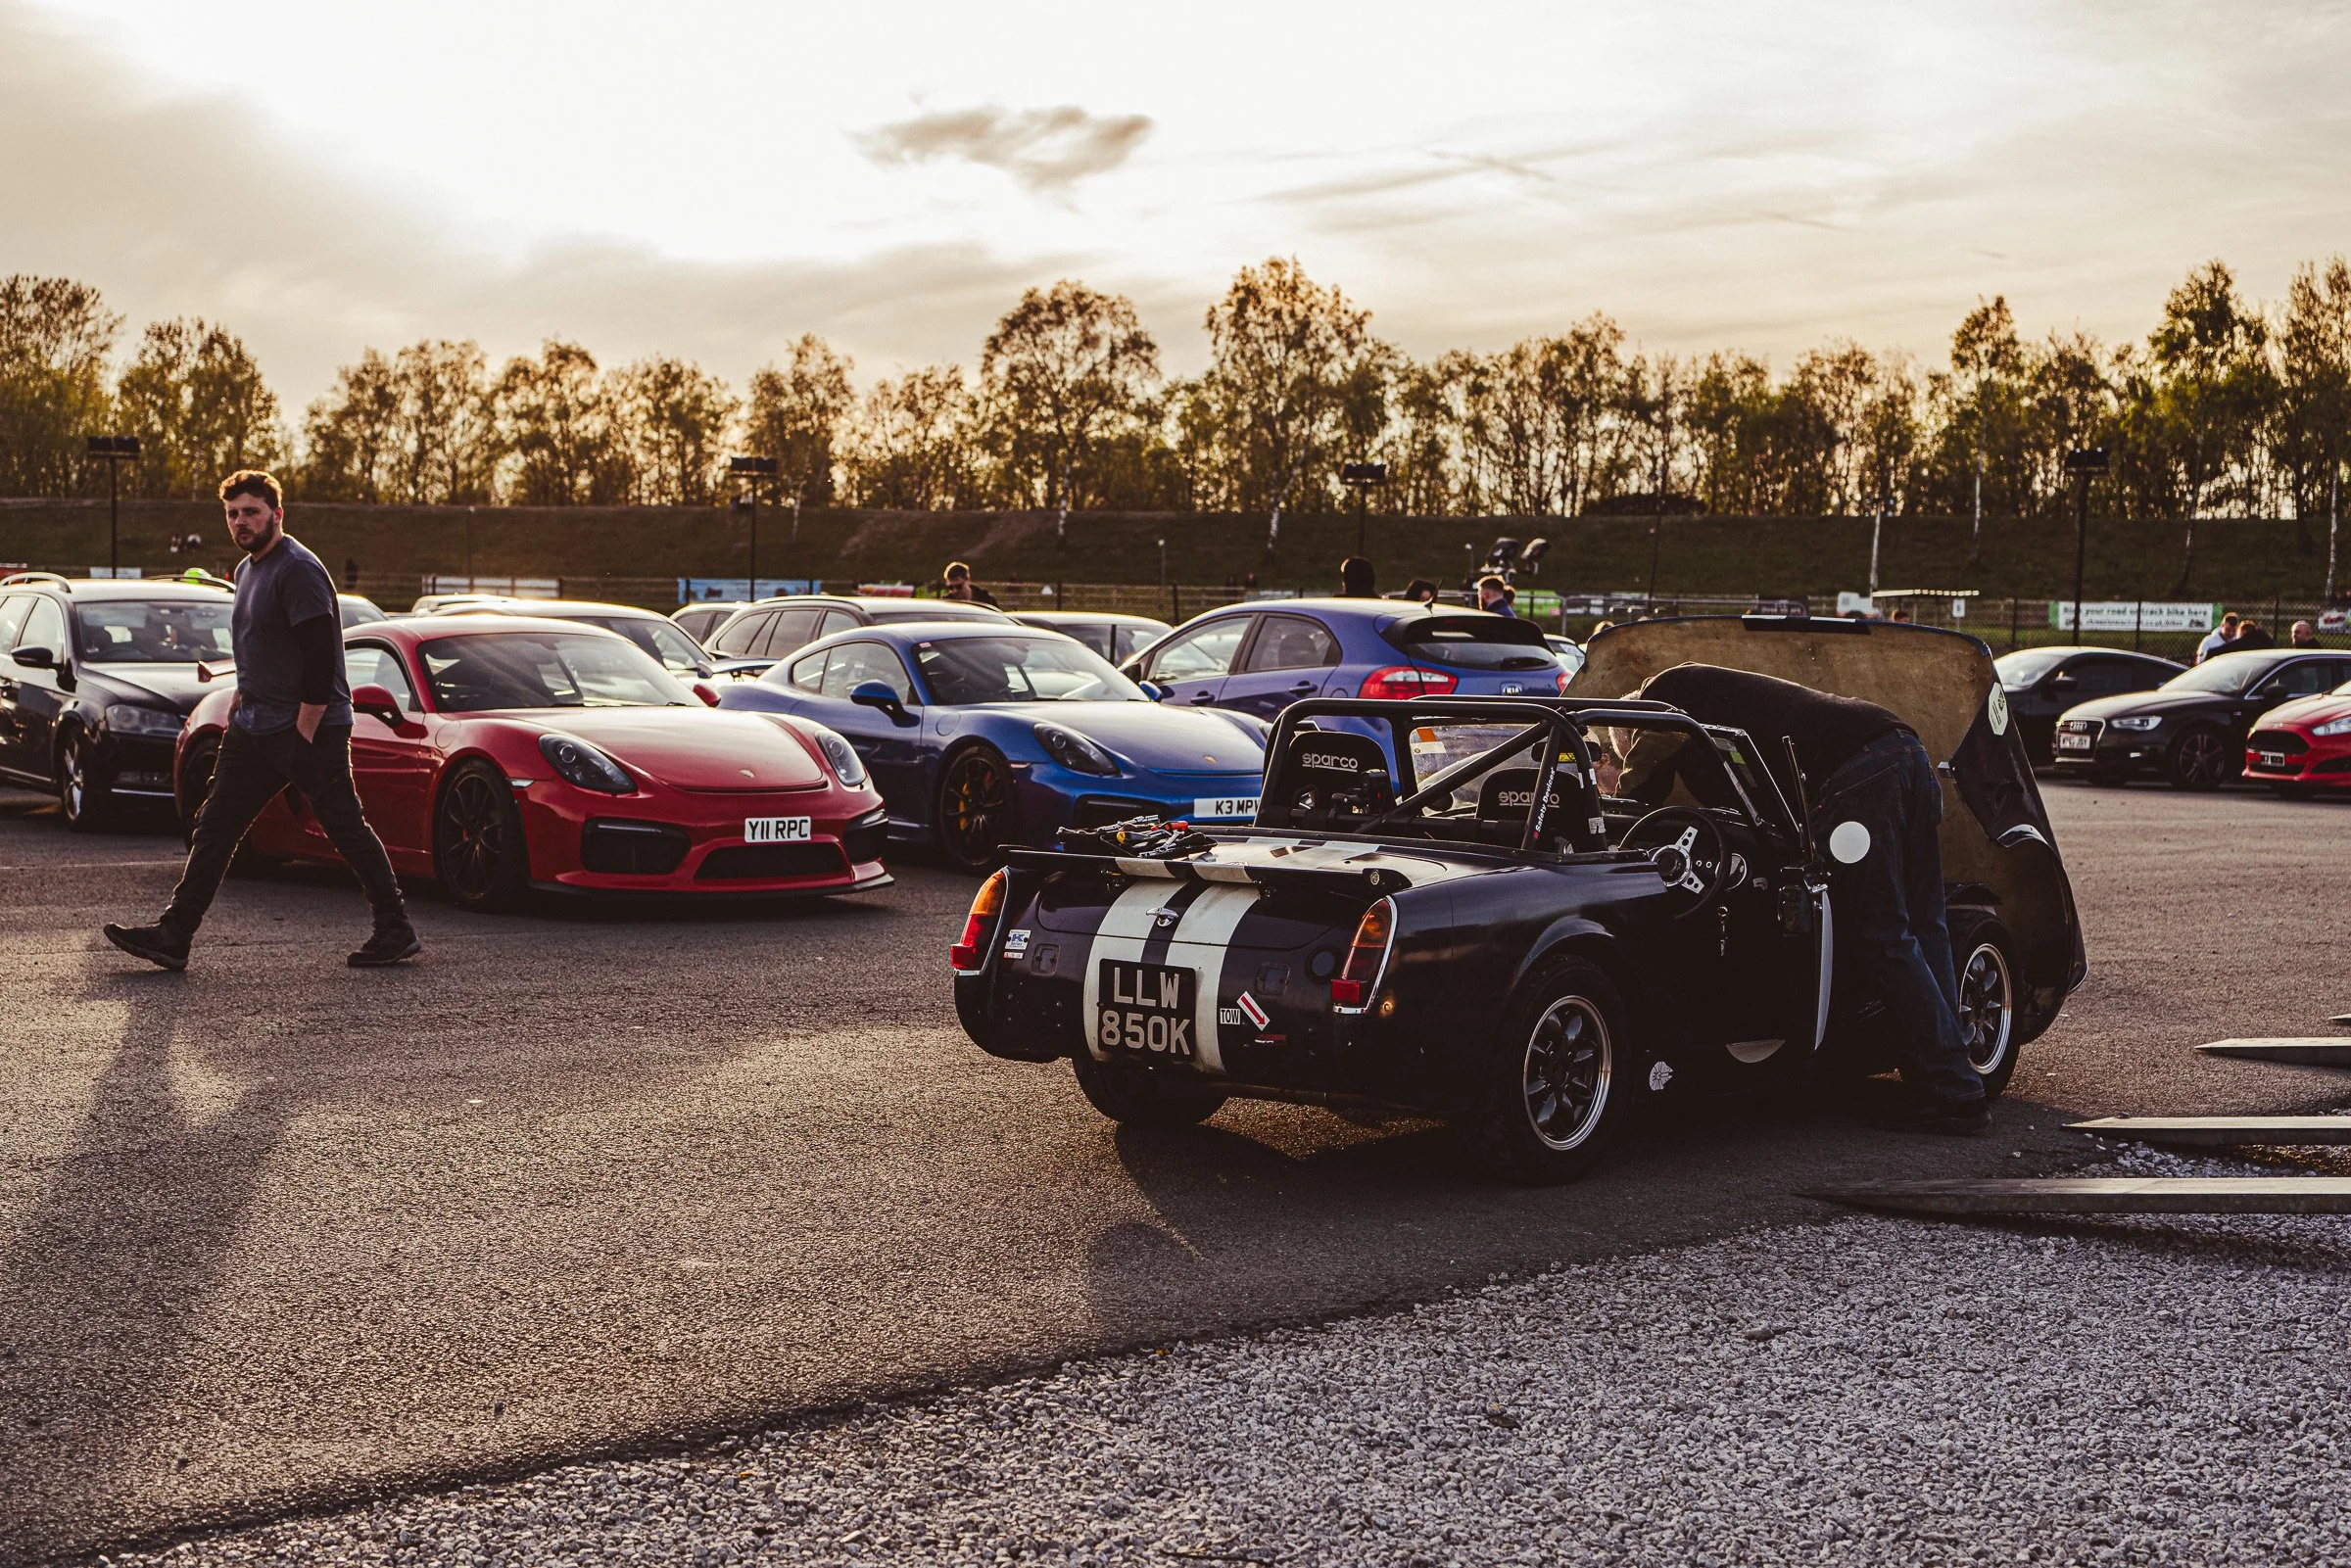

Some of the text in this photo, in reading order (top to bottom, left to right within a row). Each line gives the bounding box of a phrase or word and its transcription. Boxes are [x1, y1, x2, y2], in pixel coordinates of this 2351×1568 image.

[1302, 752, 1359, 770] sparco
[1215, 800, 1233, 815] K3
[1535, 769, 1556, 832] Safety Devices
[775, 819, 809, 839] RPC
[1114, 967, 1179, 1009] LLW
[1221, 1009, 1239, 1023] TOW
[1101, 1010, 1190, 1055] 850K
